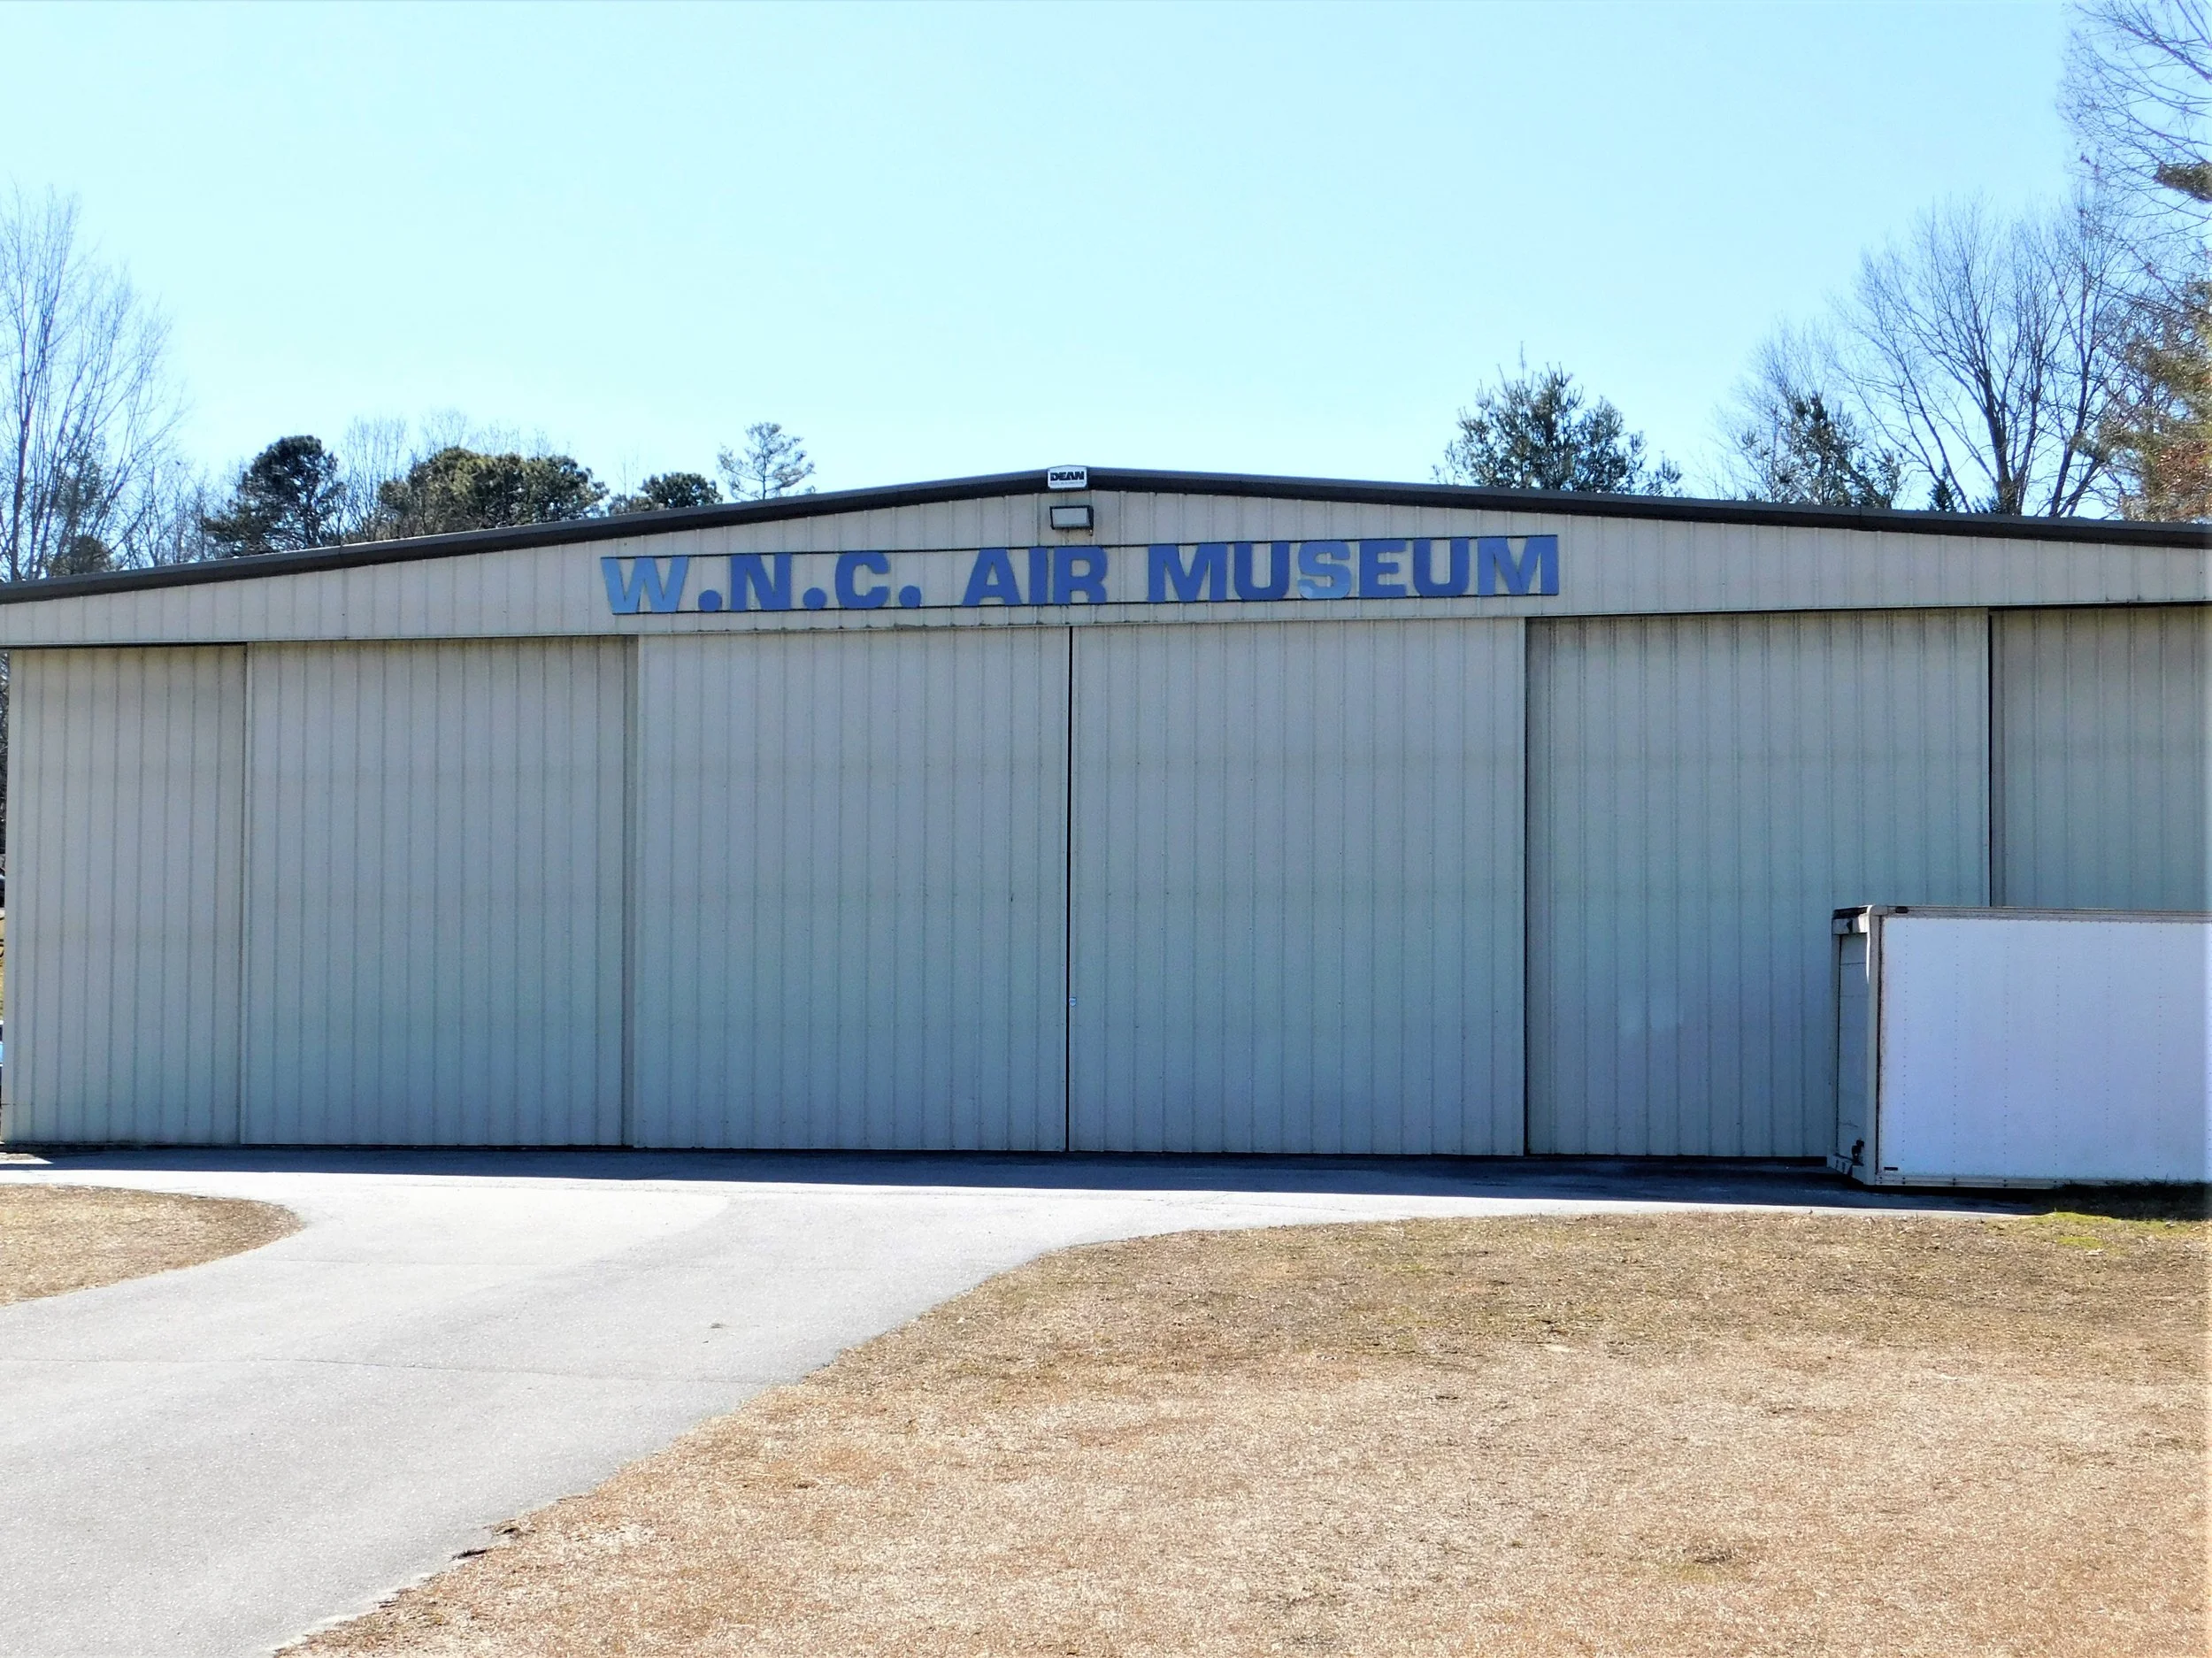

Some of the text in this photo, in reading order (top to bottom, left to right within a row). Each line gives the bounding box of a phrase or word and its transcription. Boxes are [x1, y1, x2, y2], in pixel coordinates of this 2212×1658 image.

[1050, 471, 1085, 481] DEAN
[600, 534, 1559, 613] W.N.C. AIR MUSEUM
